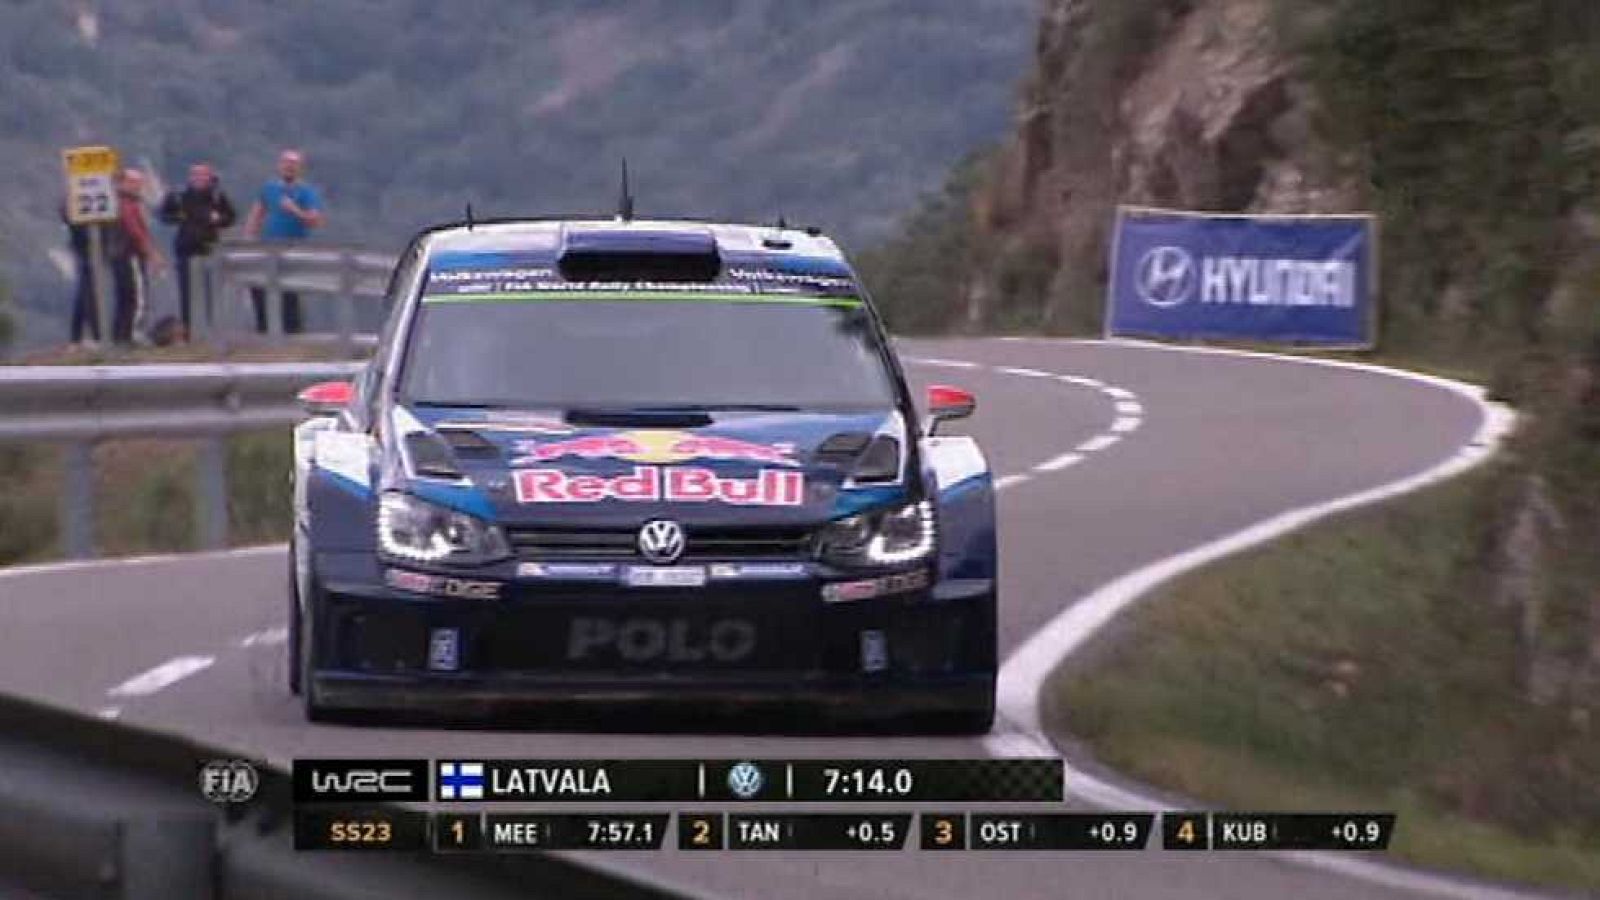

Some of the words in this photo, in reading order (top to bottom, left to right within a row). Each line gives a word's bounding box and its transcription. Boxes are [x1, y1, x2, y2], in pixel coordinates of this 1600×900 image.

[514, 465, 659, 502] Red
[663, 465, 805, 505] Bull
[567, 617, 757, 662] POLO
